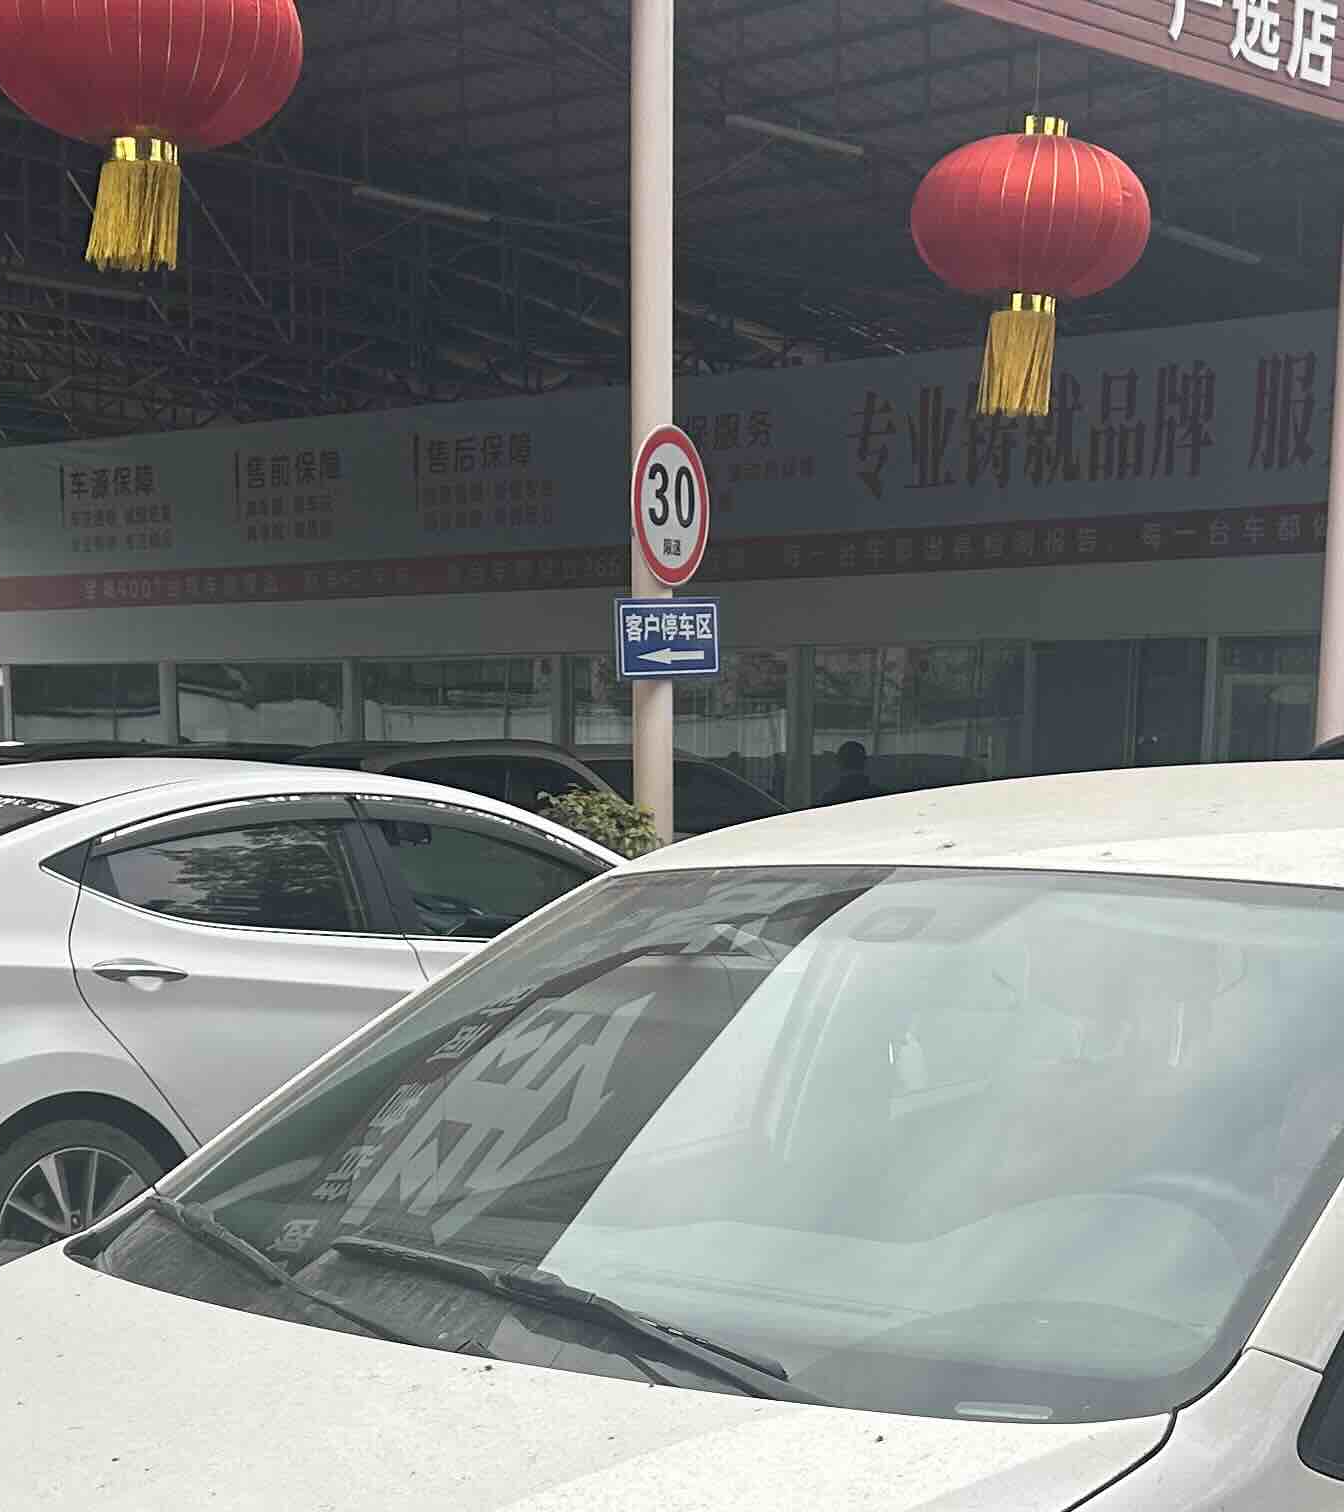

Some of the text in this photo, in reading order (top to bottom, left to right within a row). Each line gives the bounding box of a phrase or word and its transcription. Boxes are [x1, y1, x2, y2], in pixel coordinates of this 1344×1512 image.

[1168, 0, 1338, 87] 选店
[246, 447, 342, 489] 售前保障
[426, 432, 533, 473] 售后保障
[70, 464, 155, 499] 车源保障
[648, 463, 695, 528] 30
[625, 614, 713, 641] 客户停车区
